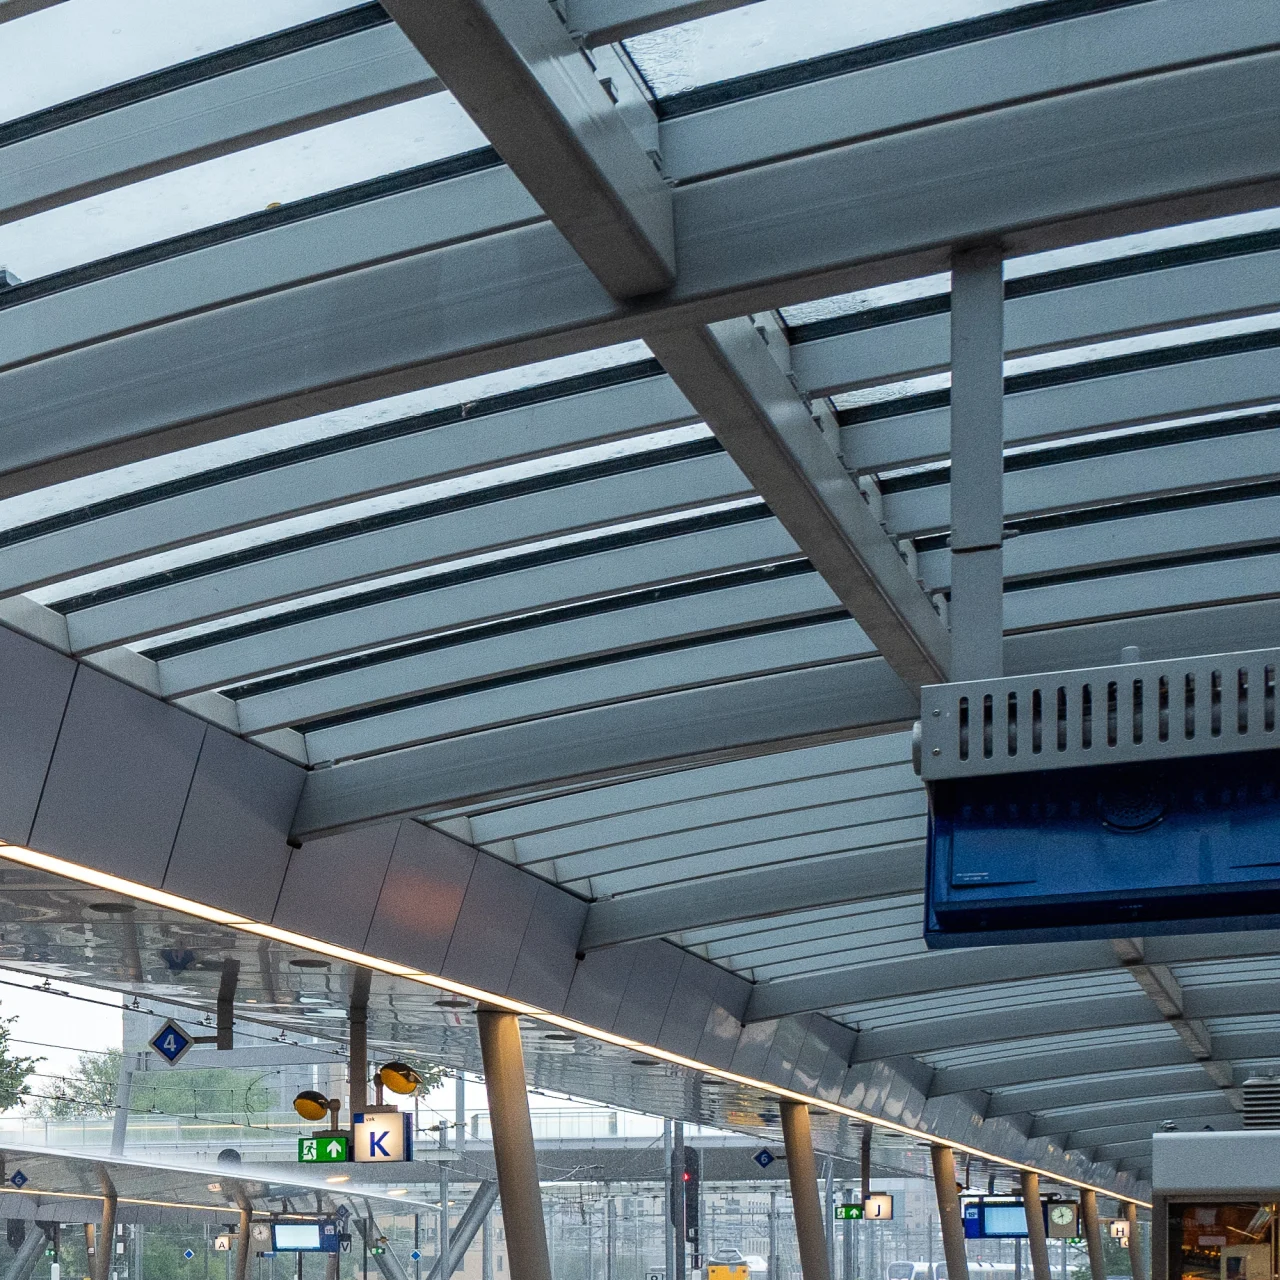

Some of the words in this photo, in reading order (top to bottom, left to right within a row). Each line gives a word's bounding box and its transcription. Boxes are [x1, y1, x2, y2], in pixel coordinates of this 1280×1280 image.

[163, 1034, 177, 1052] 4
[369, 1131, 391, 1157] K
[760, 1154, 769, 1164] 6
[15, 1175, 23, 1184] 6
[874, 1204, 881, 1218] J
[1116, 1228, 1125, 1236] H
[218, 1241, 226, 1249] A
[341, 1241, 349, 1251] V
